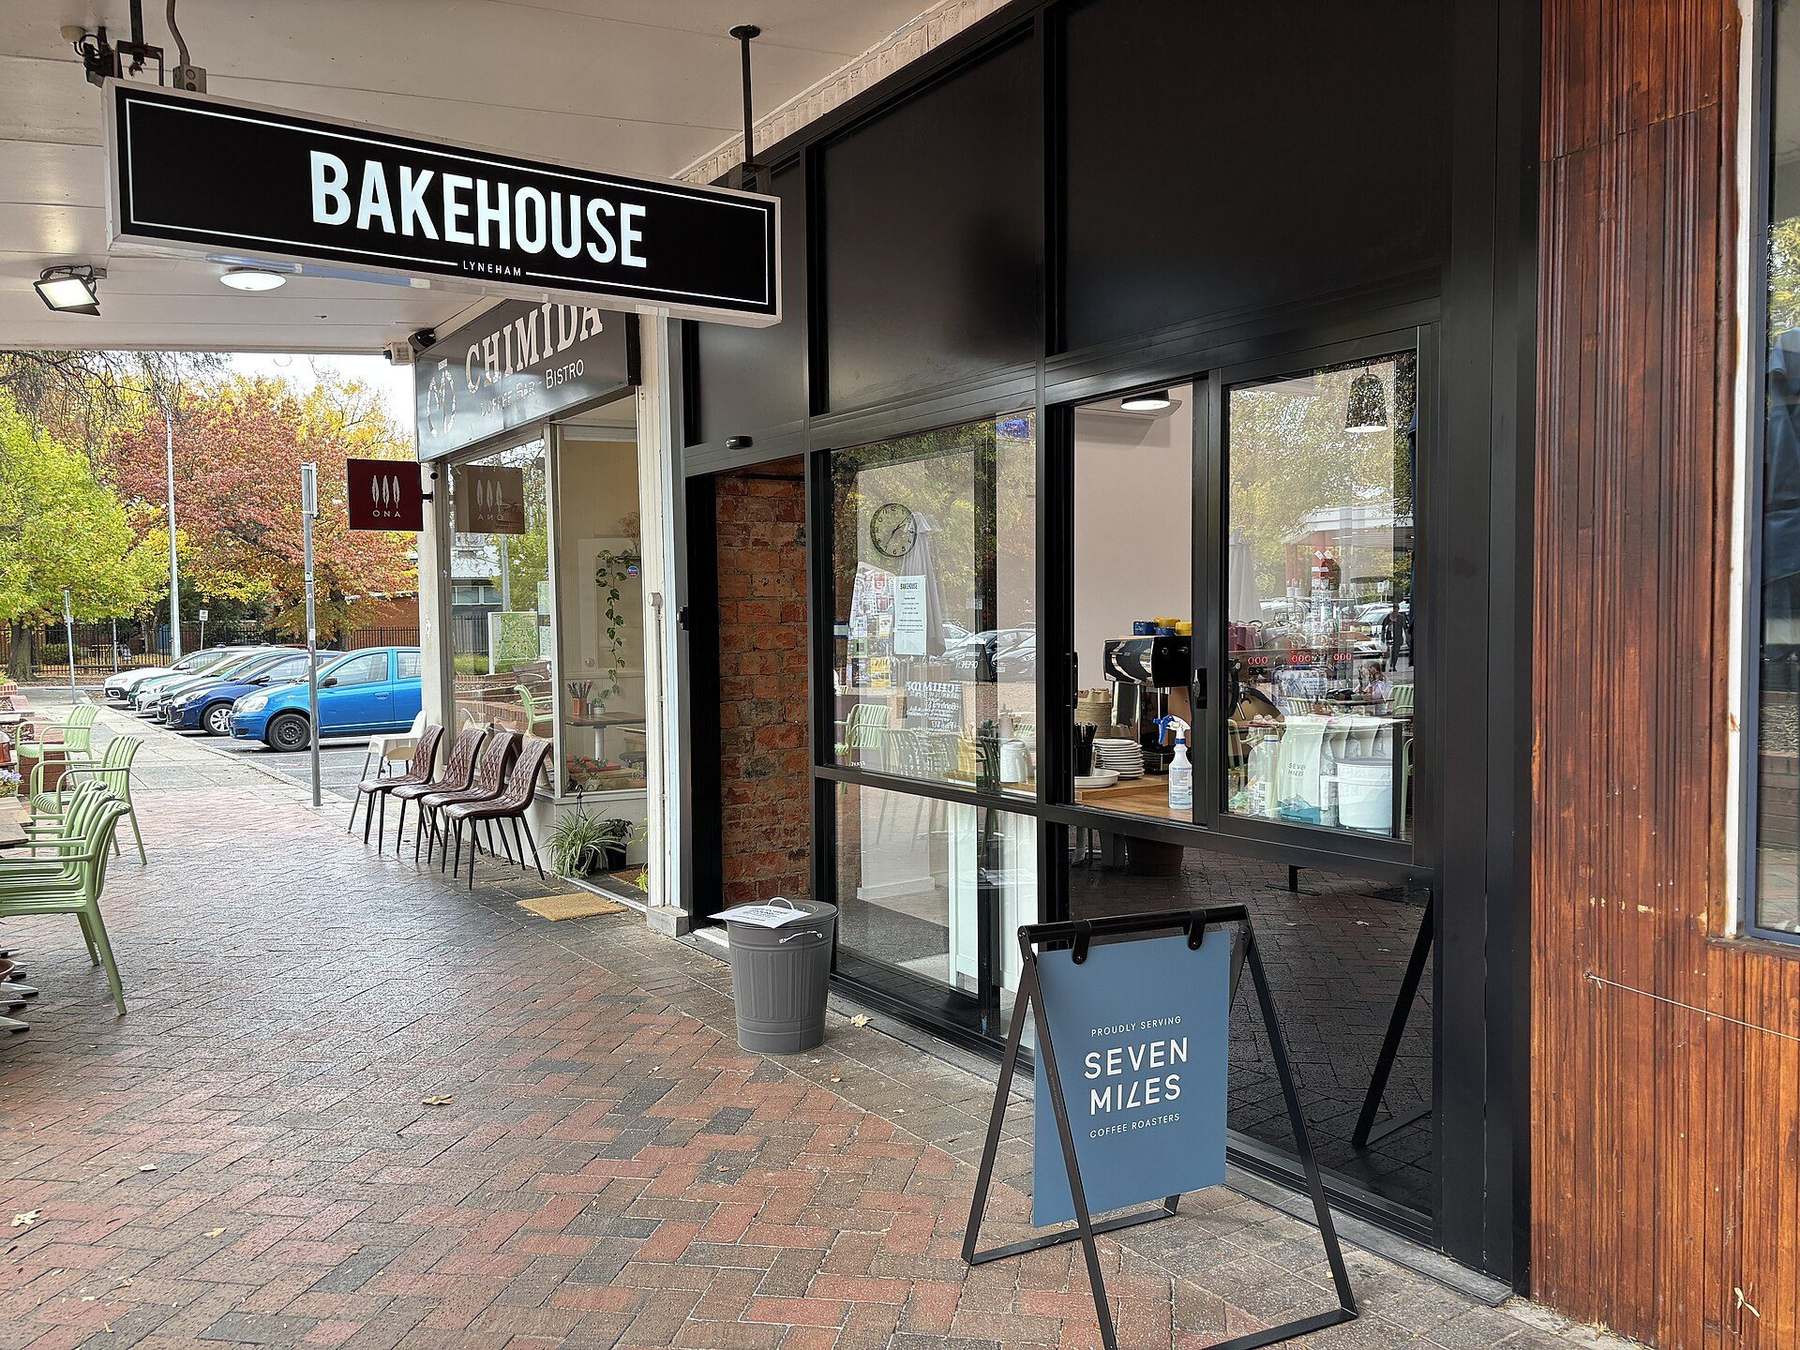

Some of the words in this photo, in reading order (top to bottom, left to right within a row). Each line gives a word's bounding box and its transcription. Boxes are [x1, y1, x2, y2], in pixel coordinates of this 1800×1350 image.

[310, 150, 647, 269] BAKEHOUSE
[463, 260, 522, 277] LYNEHAM
[465, 303, 603, 394] CHIMIDA
[372, 509, 401, 518] ONA
[1091, 1023, 1136, 1037] PROUDLY
[1140, 1016, 1181, 1030] SERVING
[1084, 1037, 1188, 1079] SEVEN
[1090, 1074, 1181, 1116] MILES
[1090, 1124, 1127, 1138] COFFEE
[1131, 1113, 1180, 1130] ROASTERS
